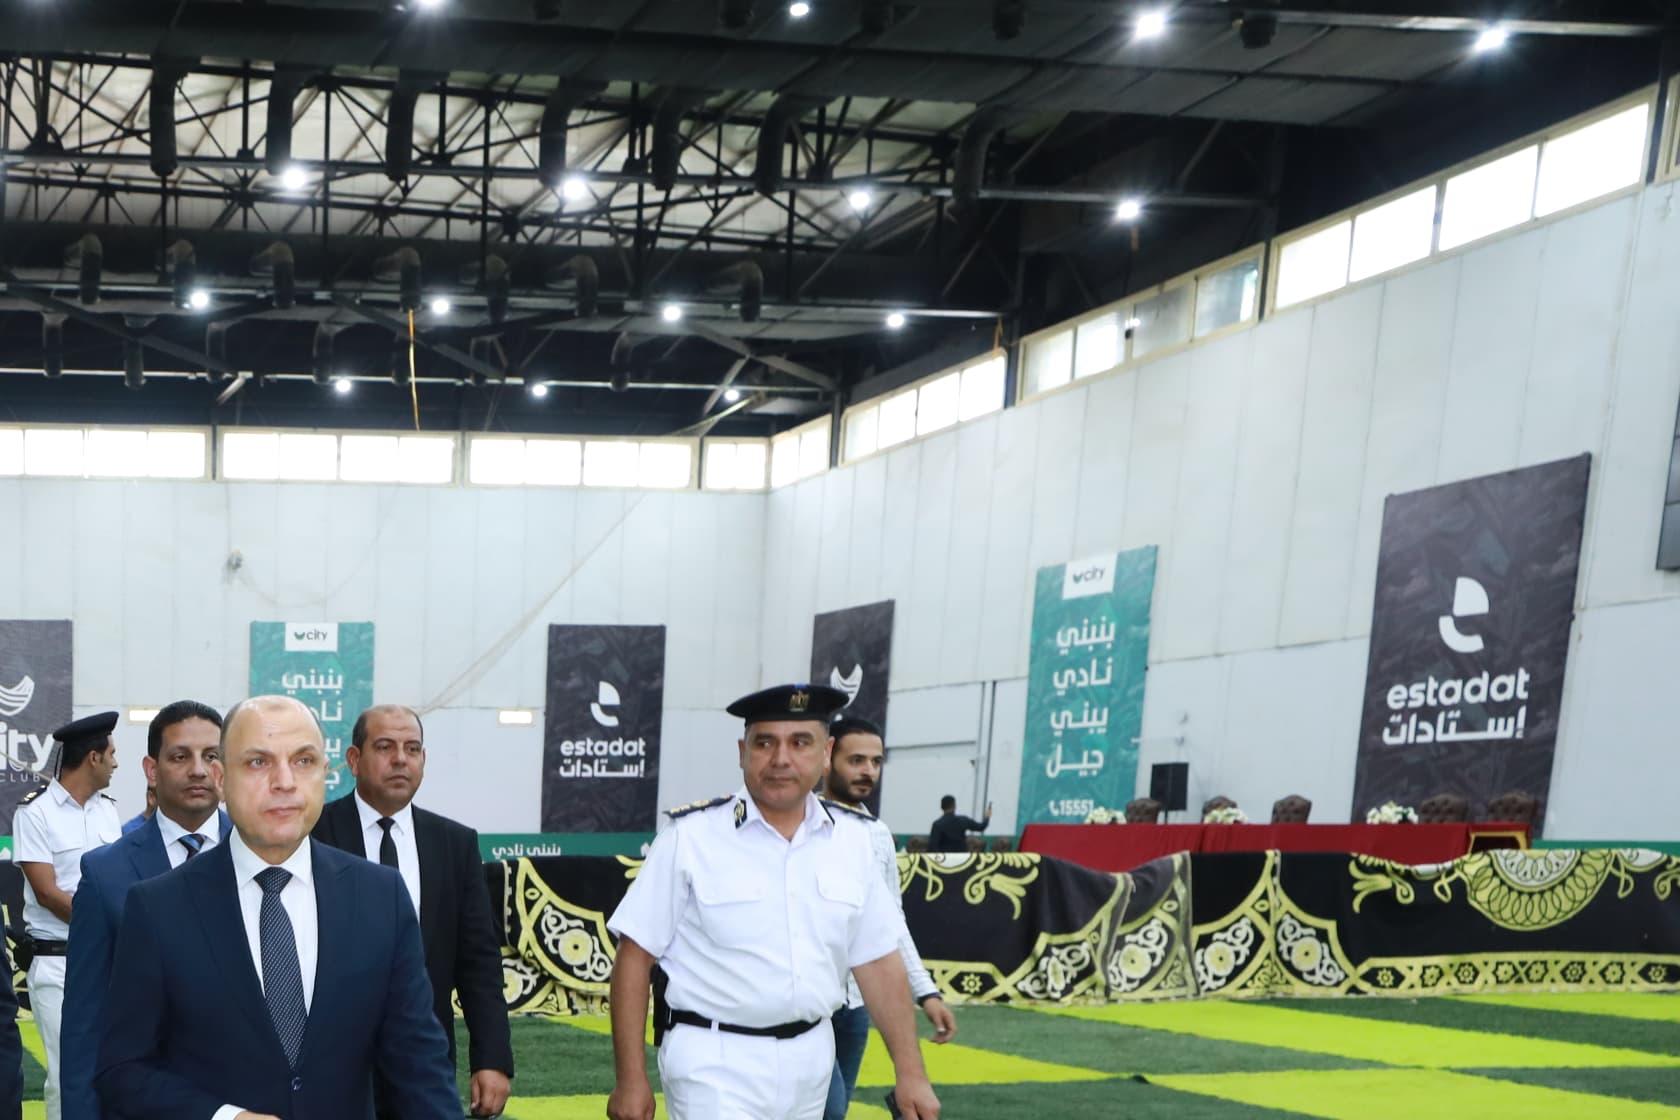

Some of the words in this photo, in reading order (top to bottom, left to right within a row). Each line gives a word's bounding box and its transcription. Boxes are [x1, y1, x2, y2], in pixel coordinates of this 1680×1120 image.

[1084, 566, 1106, 582] city
[306, 629, 327, 641] city
[1056, 615, 1115, 655] بنبني
[281, 668, 343, 695] بنبني
[1053, 656, 1113, 696] نادي
[1386, 666, 1530, 710] estadat
[1050, 701, 1108, 737] يبني
[1382, 705, 1527, 745] إستادات
[560, 737, 646, 756] estadat
[1046, 743, 1105, 778] جيل
[559, 759, 645, 778] إستادات
[492, 843, 524, 859] نادي
